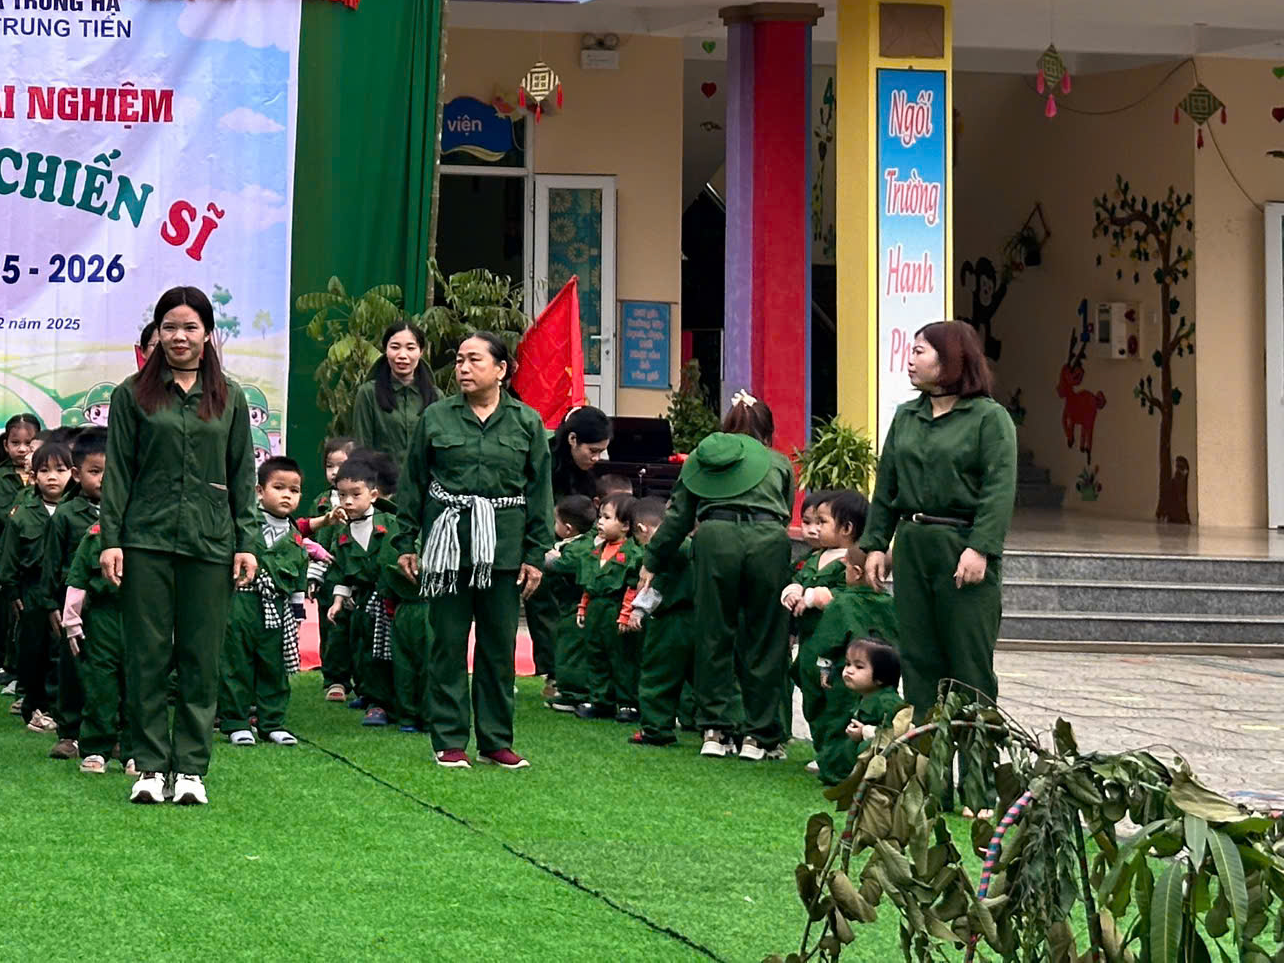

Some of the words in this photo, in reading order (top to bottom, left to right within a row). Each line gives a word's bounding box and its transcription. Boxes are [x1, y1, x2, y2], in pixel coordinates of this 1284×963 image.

[26, 80, 175, 129] NGHIỆM
[447, 114, 483, 136] viện
[886, 169, 941, 226] Trường
[160, 201, 226, 262] SĨ
[28, 267, 39, 275] -
[48, 253, 126, 284] 2026
[886, 245, 935, 304] Hạnh
[8, 317, 42, 330] năm
[46, 317, 81, 331] 2025
